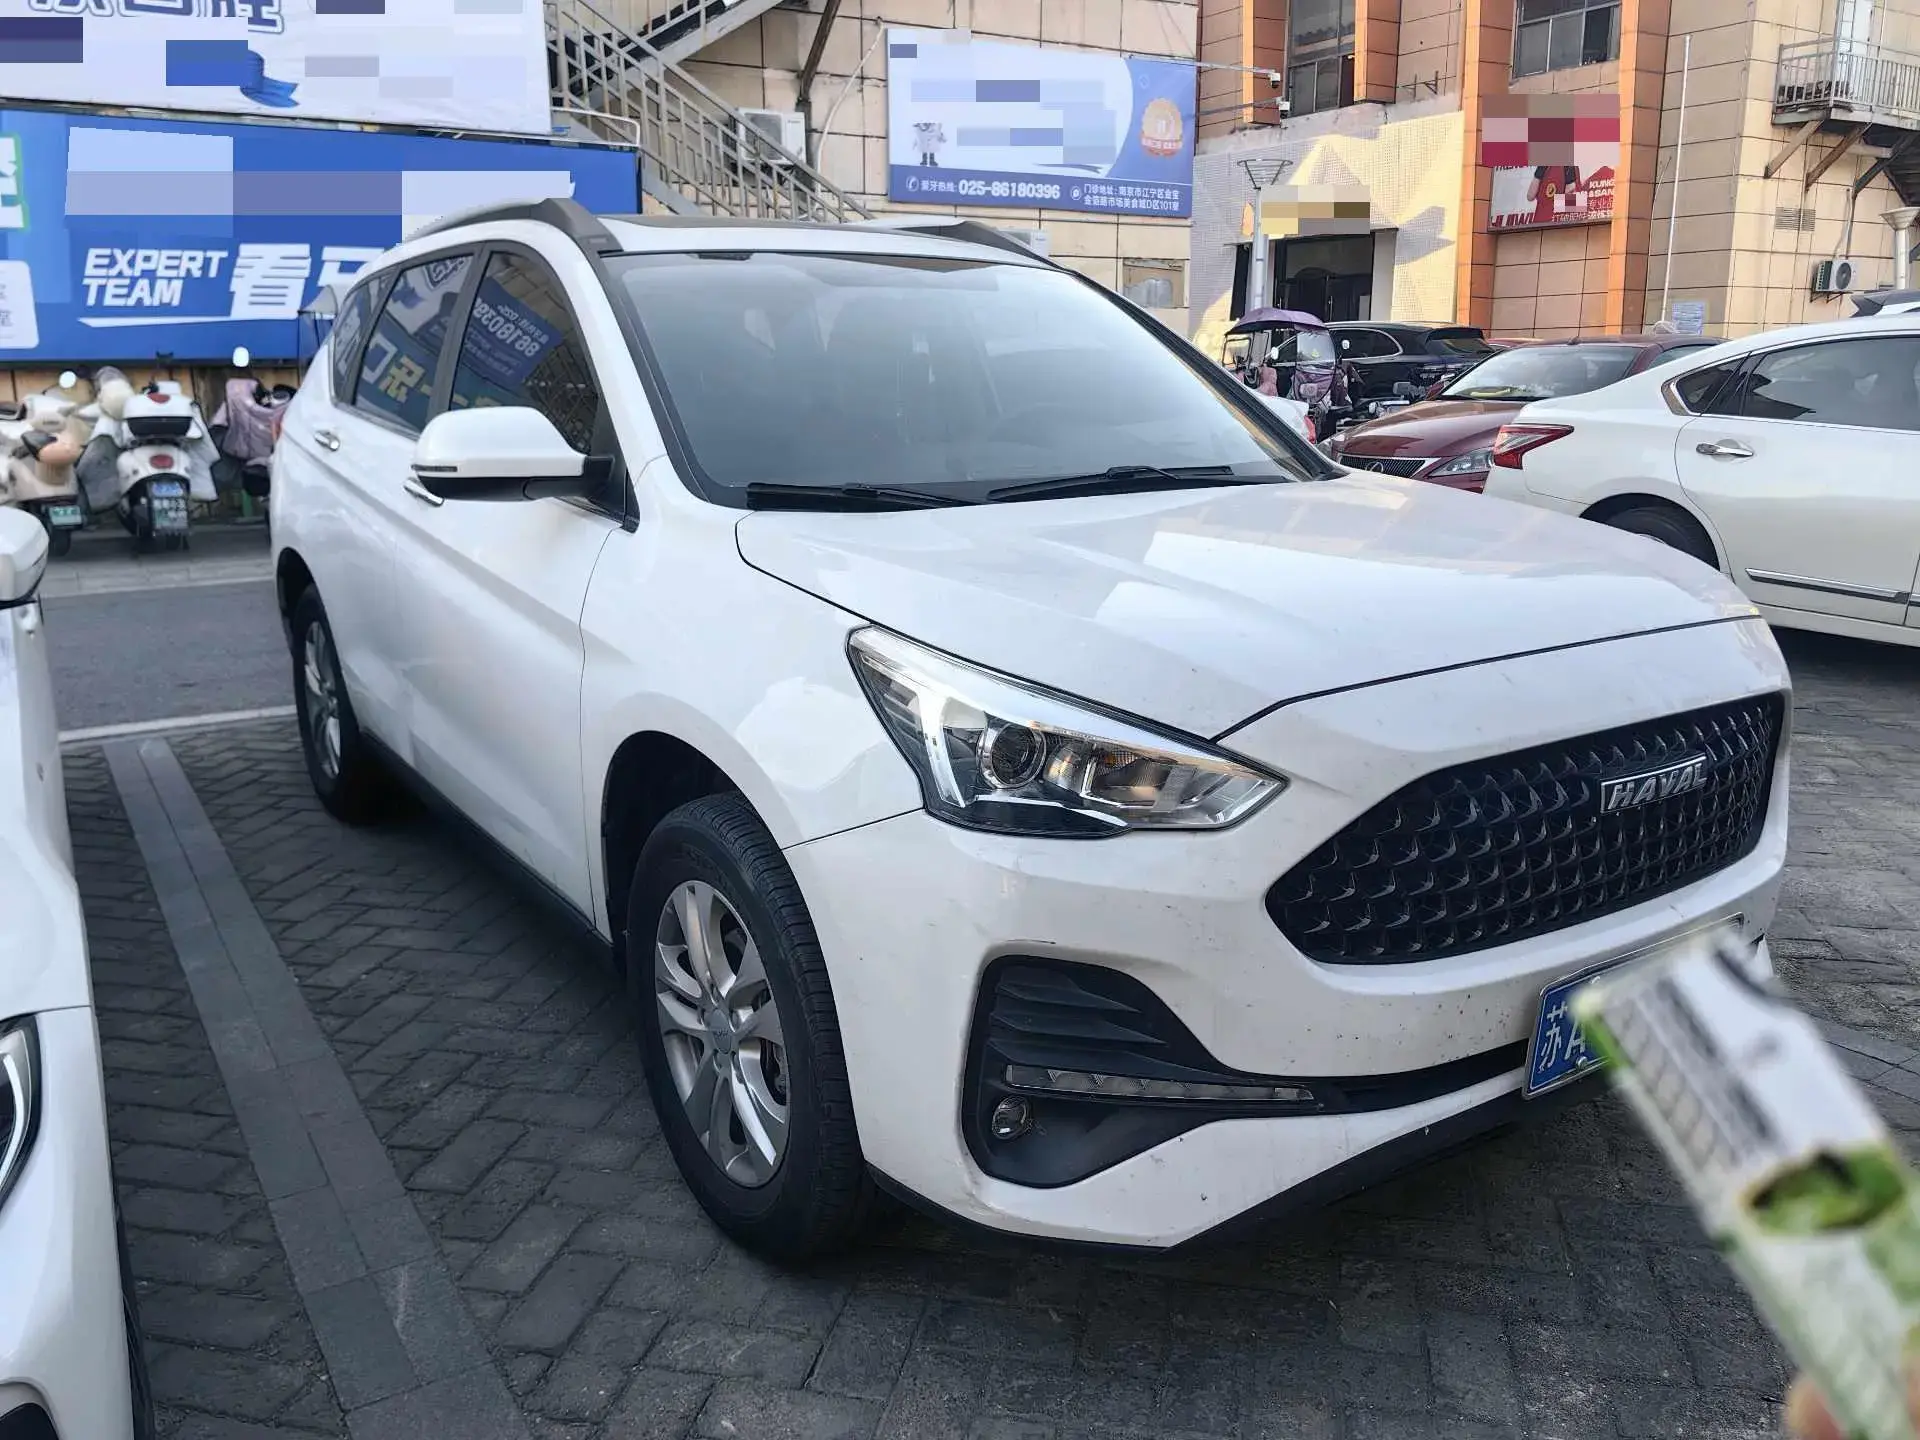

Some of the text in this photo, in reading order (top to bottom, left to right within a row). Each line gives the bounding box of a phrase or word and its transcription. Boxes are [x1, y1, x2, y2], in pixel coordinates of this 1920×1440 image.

[958, 180, 1061, 200] 025-86180396
[84, 248, 228, 278] EXPERT
[83, 277, 184, 306] TEAM
[1607, 762, 1707, 810] HAVAL
